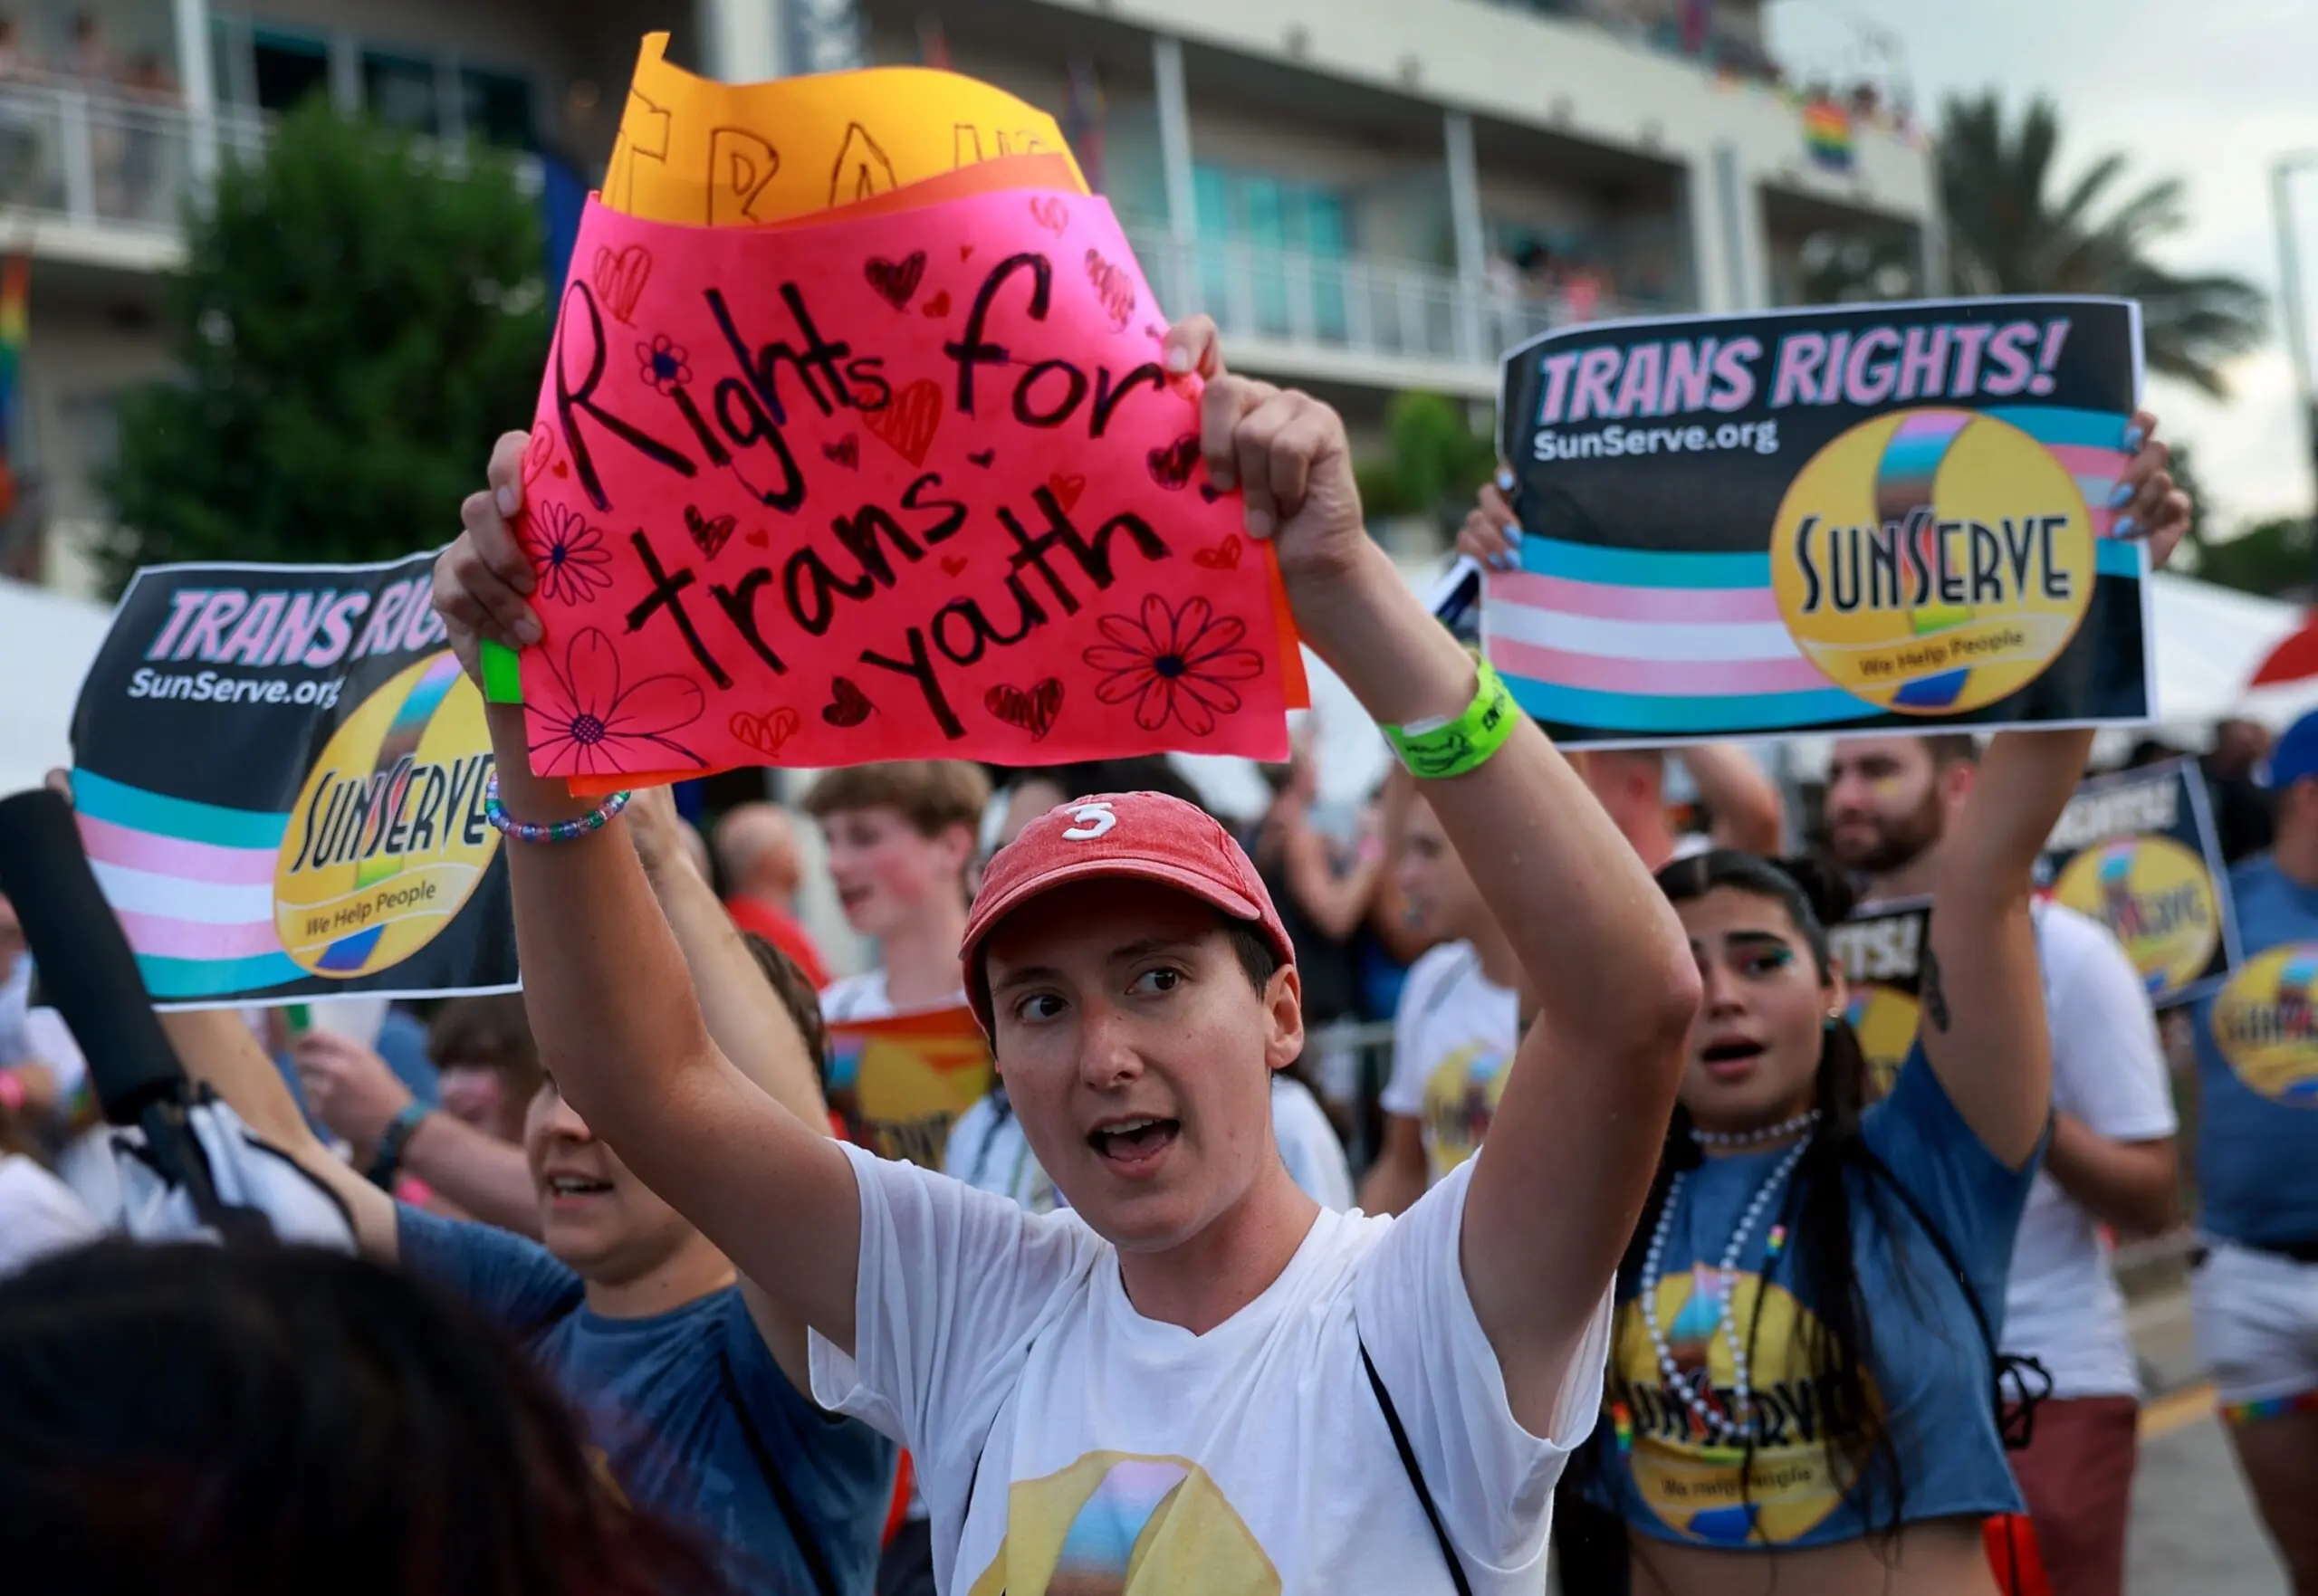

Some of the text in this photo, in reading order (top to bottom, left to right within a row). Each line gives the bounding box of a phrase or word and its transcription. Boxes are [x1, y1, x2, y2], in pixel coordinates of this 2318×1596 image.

[555, 253, 1165, 512] Rights for
[1536, 317, 2073, 426] TRANS RIGHTS!
[1534, 417, 1779, 461] SunServe.org
[624, 471, 968, 691] trans
[859, 485, 1173, 741] youth
[142, 586, 372, 669] TRANS
[1858, 627, 2026, 676] We Help People
[1061, 802, 1116, 841] 3
[304, 879, 437, 938] We Help People
